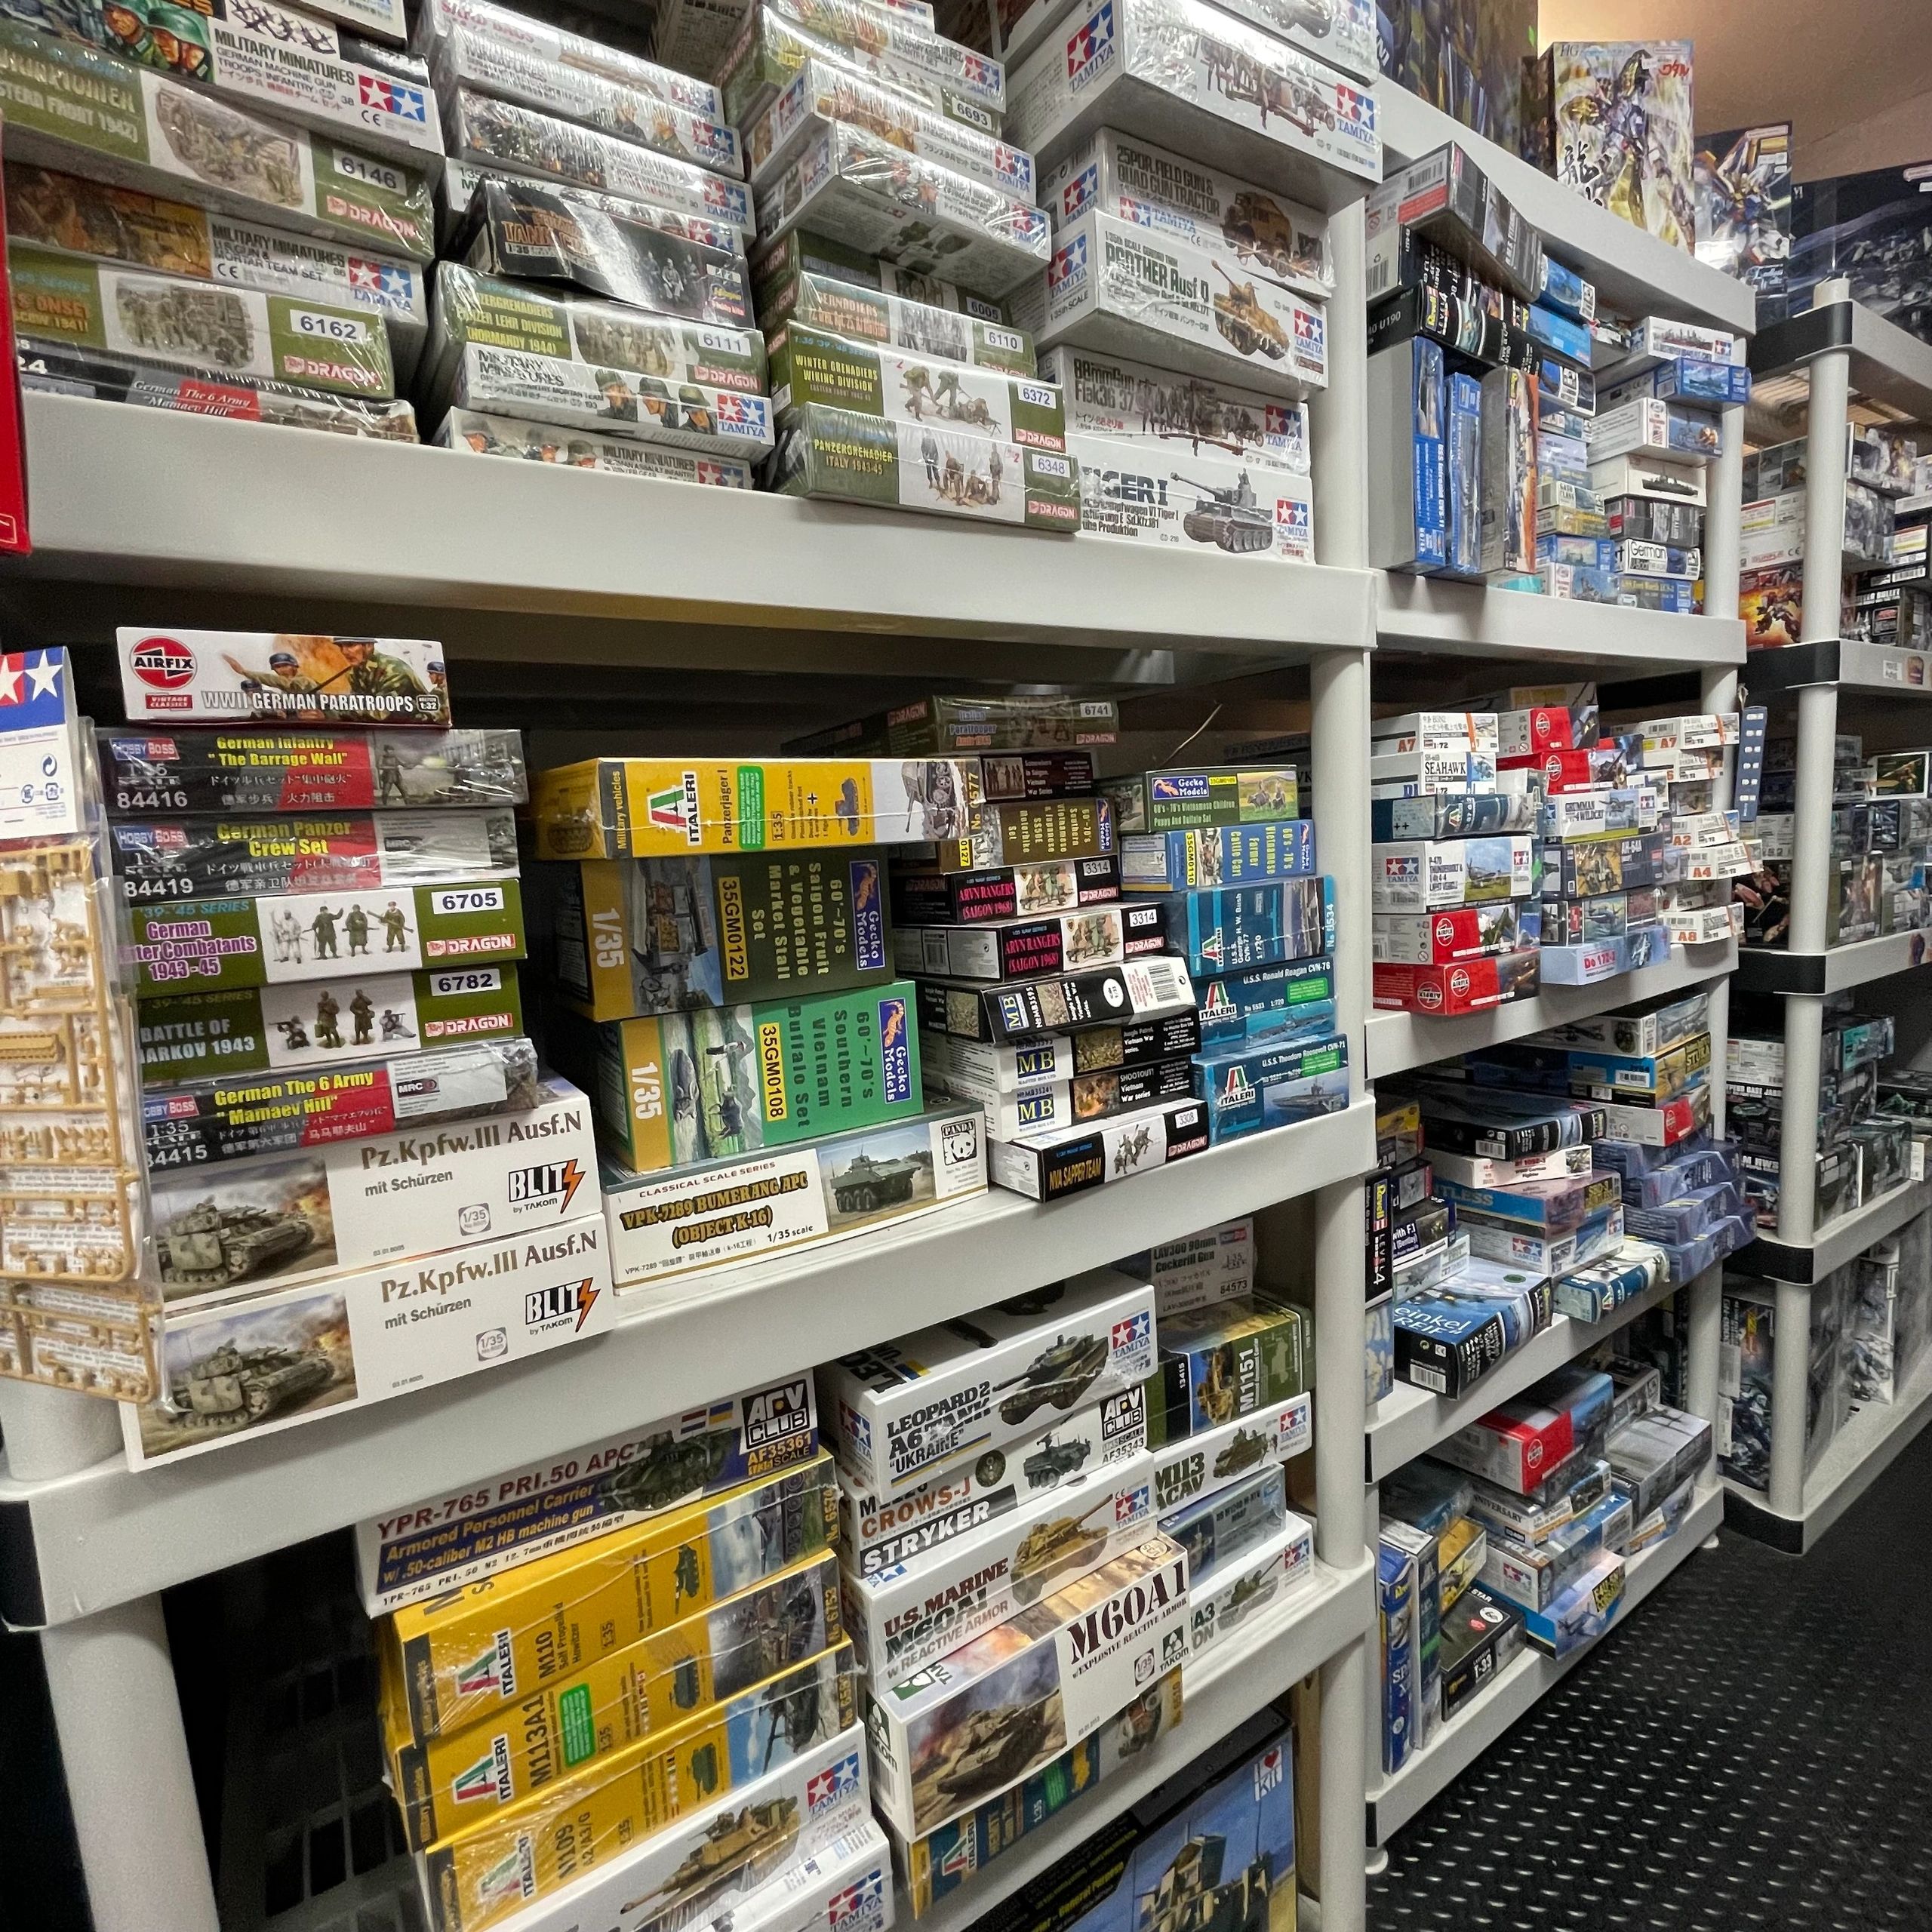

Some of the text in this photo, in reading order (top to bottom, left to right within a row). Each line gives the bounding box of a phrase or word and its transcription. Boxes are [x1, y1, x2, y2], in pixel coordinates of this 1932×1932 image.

[278, 52, 355, 86] MINIATURES
[1069, 46, 1116, 93] TAMIYA
[956, 102, 989, 126] 6693
[341, 156, 397, 189] 6146
[300, 315, 357, 339] 6162
[703, 333, 743, 353] 6111
[989, 331, 1018, 349] 6110
[795, 355, 827, 370] WINTER
[709, 371, 759, 390] DRAGON
[803, 370, 873, 392] WIKING DIVISION
[1022, 388, 1051, 406] 6372
[718, 420, 766, 438] TAMIYA
[814, 438, 894, 463] PANZERGRENADIER
[1026, 431, 1063, 451] DRAGON
[825, 456, 849, 471] ITALY
[1037, 457, 1066, 475] 6348
[1038, 503, 1076, 519] DRAGON
[1630, 540, 1668, 559] German
[134, 654, 195, 669] AIRFIX
[201, 691, 414, 712] WWII GERMAN PARATROOPS
[1084, 705, 1109, 715] 6741
[217, 737, 334, 750] German Infantry
[1397, 738, 1417, 753] A7
[1433, 741, 1449, 749] 1:72
[1660, 737, 1678, 749] A7
[1424, 761, 1467, 775] SEAHAWK
[1178, 777, 1204, 787] Gecko
[1179, 786, 1208, 797] Models
[116, 791, 189, 809] 84416
[684, 773, 700, 843] ITALERI
[718, 776, 734, 845] Panzerjäger
[293, 819, 352, 838] Panzer
[249, 838, 330, 857] Crew Set
[1673, 835, 1692, 846] A2
[1085, 861, 1109, 875] 3314
[1386, 874, 1420, 884] TAMIYA
[1692, 866, 1712, 878] A4
[122, 878, 195, 898] 84419
[981, 881, 1015, 897] RANGERS
[1088, 888, 1118, 900] DRAGON
[441, 891, 498, 910] 6705
[721, 879, 747, 979] 35GM0122
[752, 909, 767, 941] Set
[768, 864, 791, 980] Market Stall
[789, 881, 809, 977] Vegetable
[808, 862, 830, 976] Saigon Fruit
[1132, 912, 1156, 925] 3314
[146, 920, 211, 940] German
[592, 907, 626, 969] 1/35
[857, 909, 880, 968] Gecko Models
[1437, 926, 1454, 938] AIRFIX
[1678, 931, 1697, 943] A8
[160, 936, 257, 960] Combatants
[448, 935, 512, 953] DRAGON
[1026, 933, 1060, 950] RANGERS
[1134, 937, 1163, 953] DRAGON
[198, 958, 221, 975] 45
[438, 973, 493, 992] 6782
[1451, 977, 1470, 990] AIRFIX
[446, 1014, 509, 1033] DRAGON
[1003, 996, 1022, 1029] MB
[1199, 1005, 1236, 1020] ITALERI
[209, 1019, 231, 1035] OF
[211, 1036, 256, 1056] 1943
[786, 1004, 810, 1129] Buffalo Set
[811, 1018, 829, 1108] Vietnam
[834, 1009, 853, 1108] Southern
[896, 1044, 908, 1094] Gecko
[1018, 1050, 1054, 1075] MB
[762, 1026, 785, 1118] 35GM0108
[884, 1048, 897, 1103] Models
[214, 1071, 374, 1106] German The 6 Army
[398, 1082, 424, 1093] MRC
[630, 1061, 663, 1121] 1/35
[1220, 1090, 1255, 1106] ITALERI
[1018, 1098, 1054, 1123] MB
[943, 1119, 976, 1137] PANDA
[361, 1109, 583, 1172] Pz.Kpfw.III Ausf.N
[365, 1169, 454, 1197] mit Schürzen
[639, 1161, 777, 1198] CLASSICAL SCALE SERIES
[694, 1171, 810, 1214] BUMERANG APC
[1376, 1184, 1387, 1220] Revell
[462, 1209, 488, 1223] 1/35
[672, 1204, 774, 1250] (OBJECT K-16)
[767, 1224, 814, 1244] 1/35 scale
[1378, 1233, 1386, 1272] LEVEL
[380, 1229, 598, 1304] Pz.Kpfw.III Ausf.N
[1220, 1280, 1247, 1295] 84573
[384, 1297, 472, 1330] mit Schürzen
[480, 1334, 503, 1349] 1/35
[1112, 1335, 1151, 1358] TAMIYA
[1238, 1349, 1255, 1414] M1151
[886, 1380, 991, 1438] LEOPARD 2
[749, 1411, 806, 1444] CLUB
[1105, 1411, 1143, 1438] CLUB
[748, 1432, 812, 1466] AF35361
[774, 1445, 811, 1466] SCALE
[1102, 1437, 1145, 1466] AF35343
[377, 1441, 636, 1541] YPR-765 PRI.50 APC
[860, 1476, 973, 1539] CROWS-J
[386, 1483, 594, 1561] Armored Personnel Carrier
[475, 1504, 595, 1555] M2 HB machine gun
[863, 1499, 991, 1574] STRYKER
[923, 1557, 1010, 1613] MARINE
[1471, 1588, 1494, 1603] STAR
[1066, 1558, 1189, 1666] M60A1
[900, 1599, 1010, 1669] REACTIVE ARMOR
[500, 1629, 516, 1696] ITALERI
[535, 1630, 556, 1680] M110
[524, 1694, 552, 1790] M113A1
[497, 1735, 516, 1801] ITALERI
[808, 1780, 860, 1814] TAMIYA
